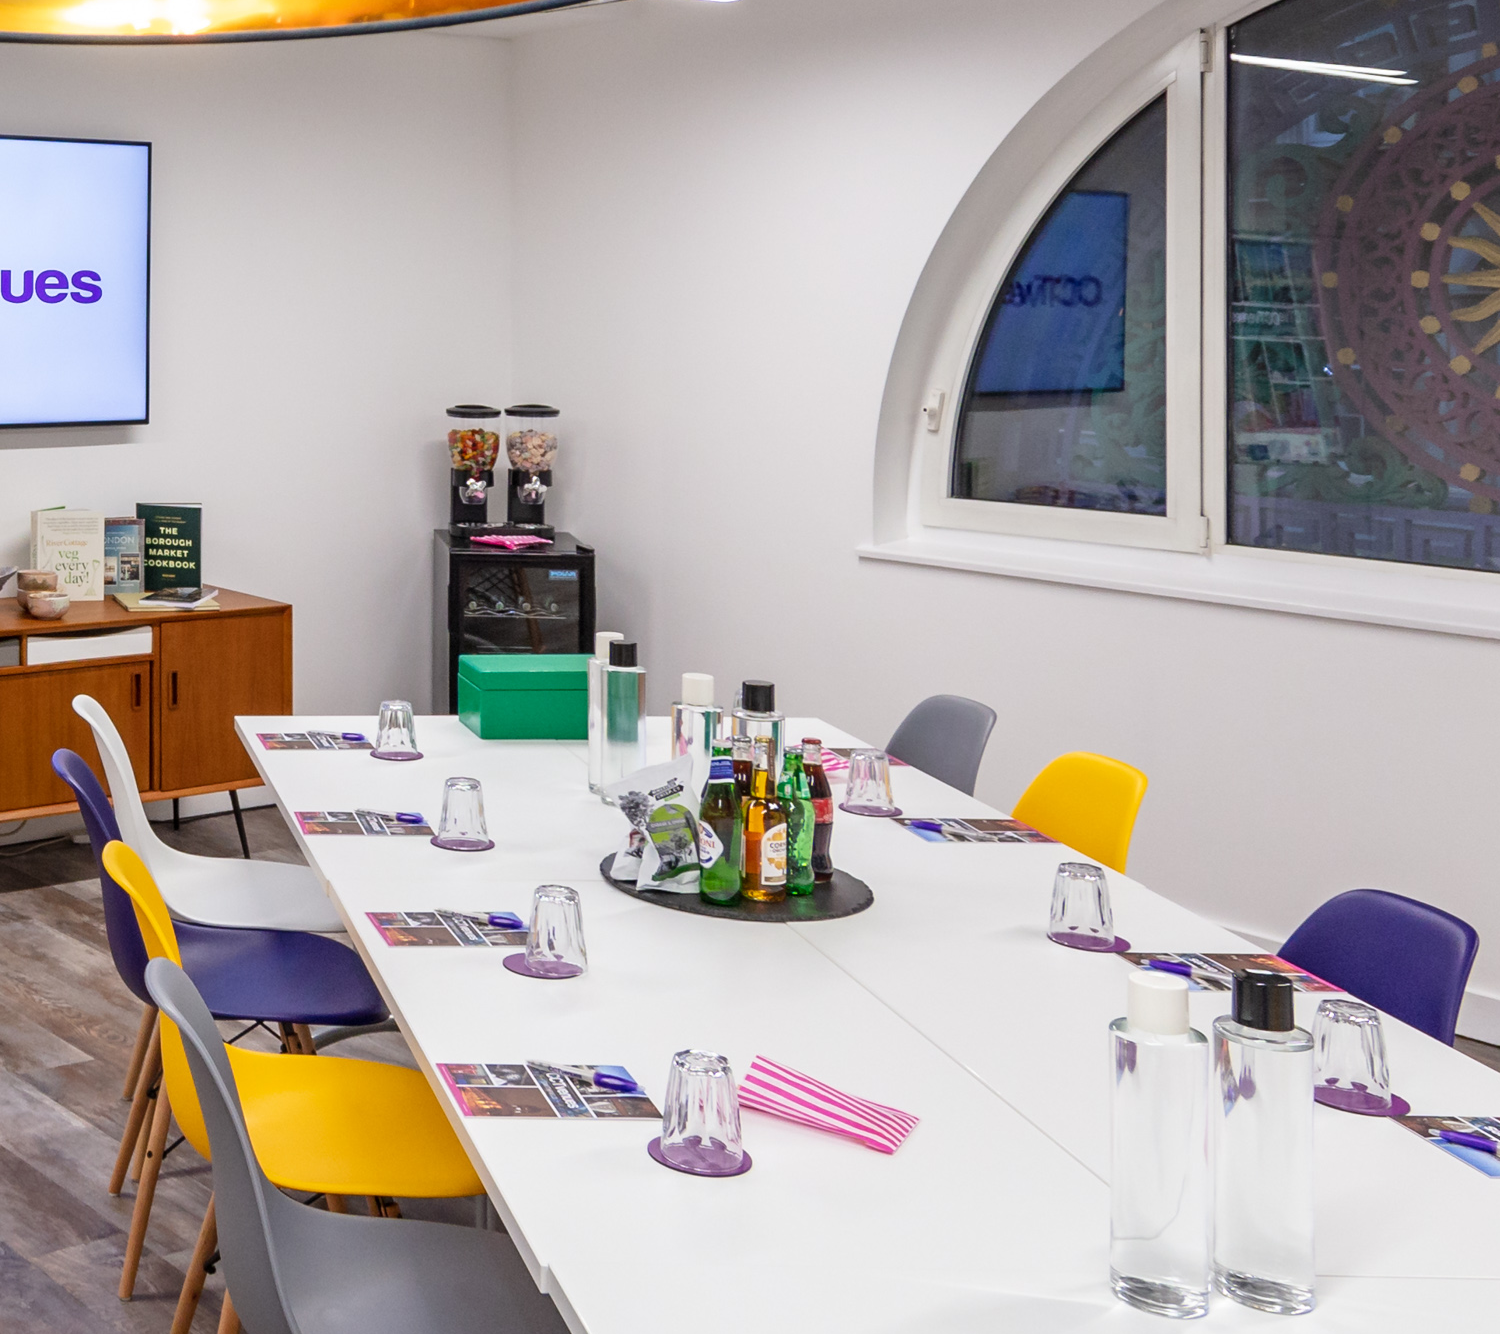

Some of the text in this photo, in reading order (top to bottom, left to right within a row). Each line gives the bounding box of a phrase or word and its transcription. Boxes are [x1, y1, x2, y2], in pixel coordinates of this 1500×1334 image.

[159, 526, 178, 536] THE
[46, 539, 63, 547] River
[146, 536, 193, 547] BOROUGH
[58, 549, 79, 561] veg
[149, 548, 189, 558] MARKET
[55, 561, 89, 573] every
[144, 559, 196, 570] COOKBOOK
[64, 571, 89, 588] day!
